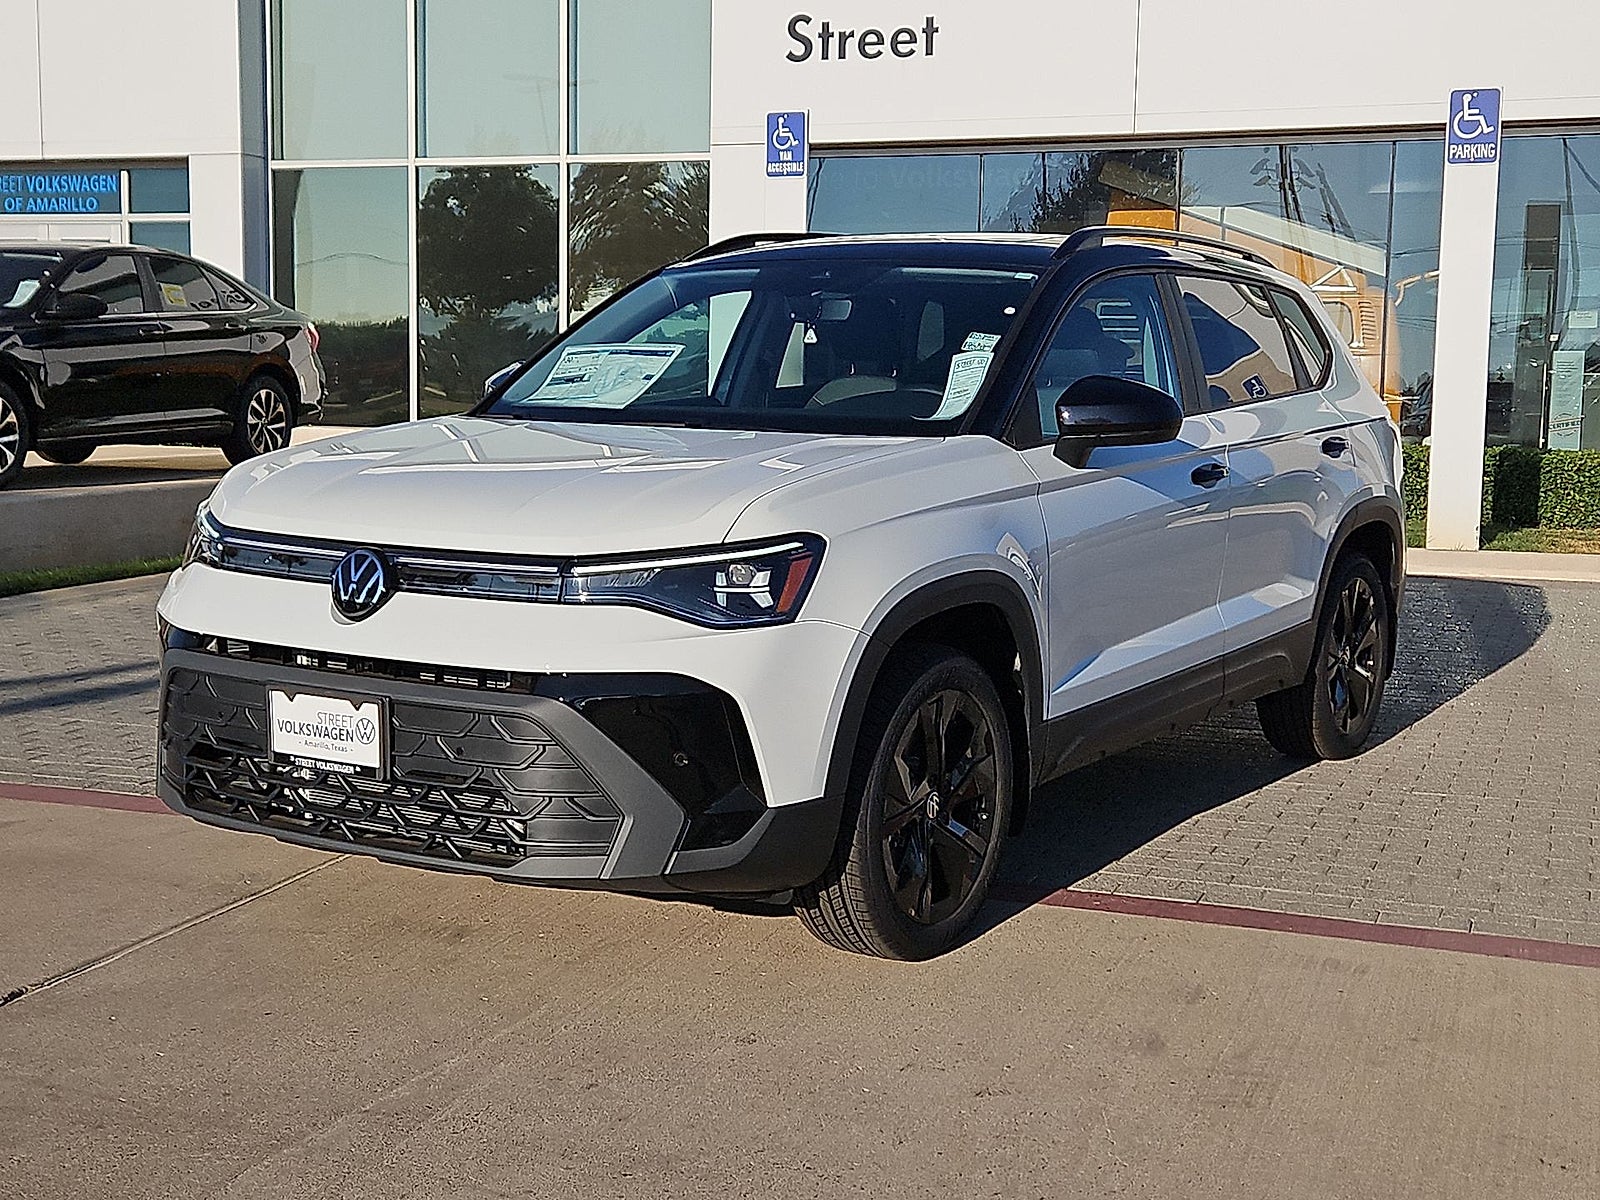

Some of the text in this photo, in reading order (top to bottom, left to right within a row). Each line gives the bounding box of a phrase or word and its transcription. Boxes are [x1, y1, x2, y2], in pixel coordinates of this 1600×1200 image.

[786, 14, 939, 62] Street
[1449, 143, 1496, 159] PARKING
[768, 161, 803, 173] ACCESSIBLE
[26, 174, 118, 193] VOLKSWAGEN
[4, 197, 98, 212] OF AMARILLO
[317, 711, 354, 728] STREET
[277, 718, 354, 742] VOLKSWAGEN
[295, 757, 315, 769] STREET
